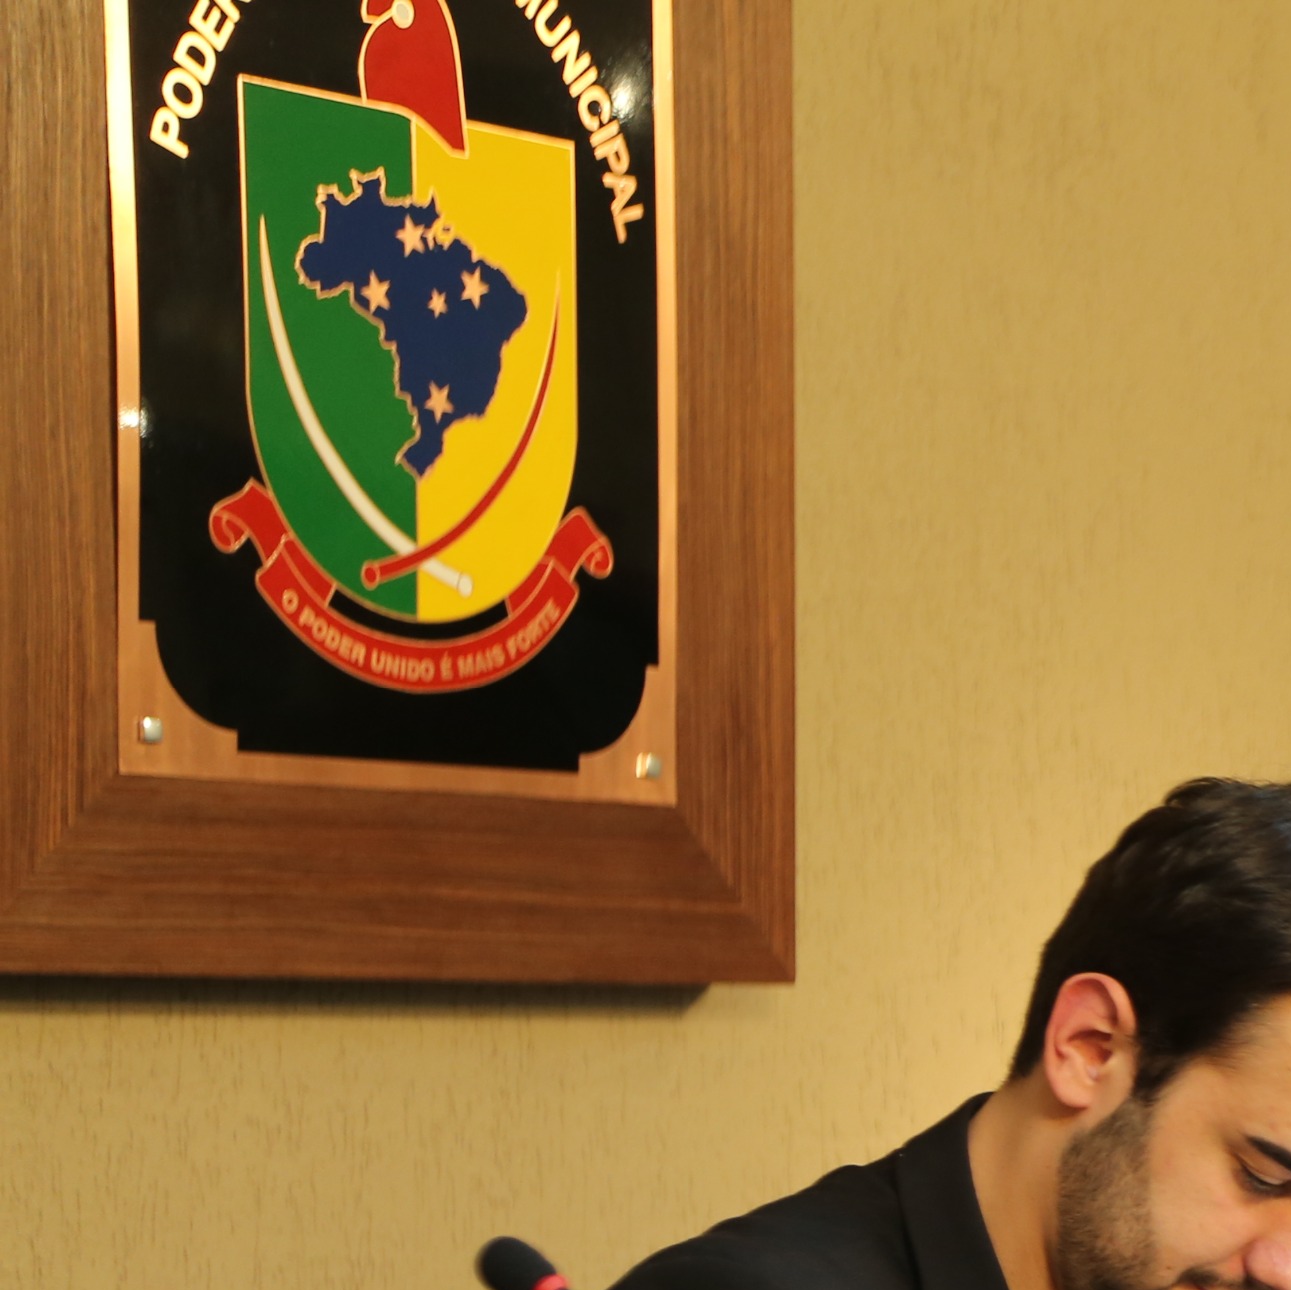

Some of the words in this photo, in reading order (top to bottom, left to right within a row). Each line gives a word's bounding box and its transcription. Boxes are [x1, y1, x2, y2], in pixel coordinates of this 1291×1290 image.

[150, 0, 251, 160] PODE
[281, 588, 299, 614] O
[299, 605, 366, 668] PODER
[371, 648, 435, 683] UNIDO
[440, 651, 453, 680] É
[457, 644, 506, 679] MAIS
[506, 597, 561, 659] FORTE
